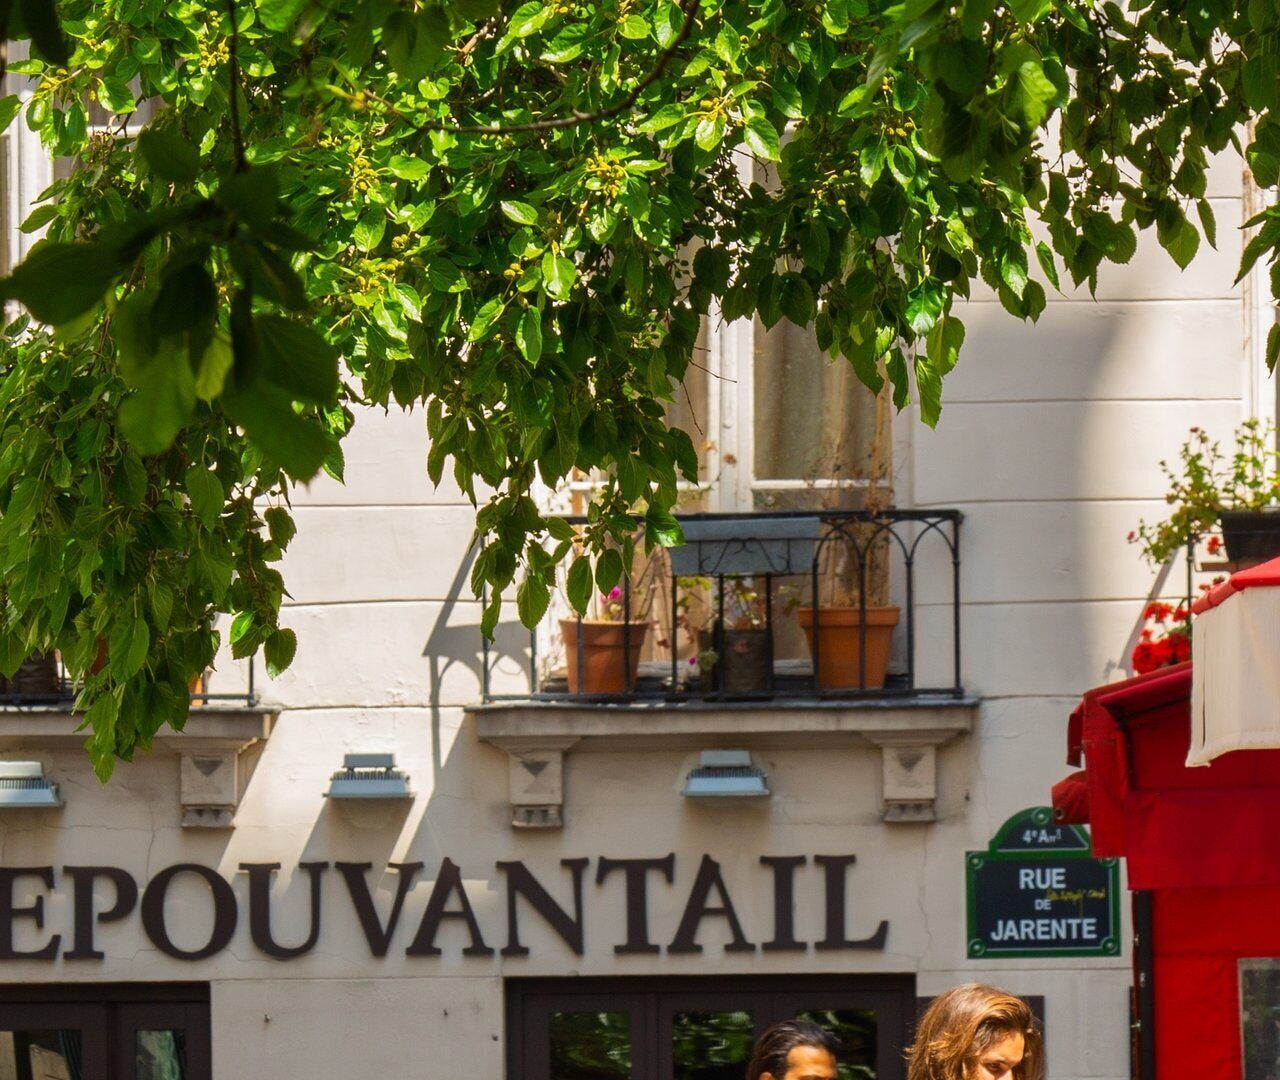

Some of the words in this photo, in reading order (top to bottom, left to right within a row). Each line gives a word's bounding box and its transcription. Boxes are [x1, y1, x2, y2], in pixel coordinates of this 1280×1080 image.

[1019, 868, 1066, 889] RUE
[1035, 899, 1052, 910] DE
[990, 918, 1097, 941] JARENTE
